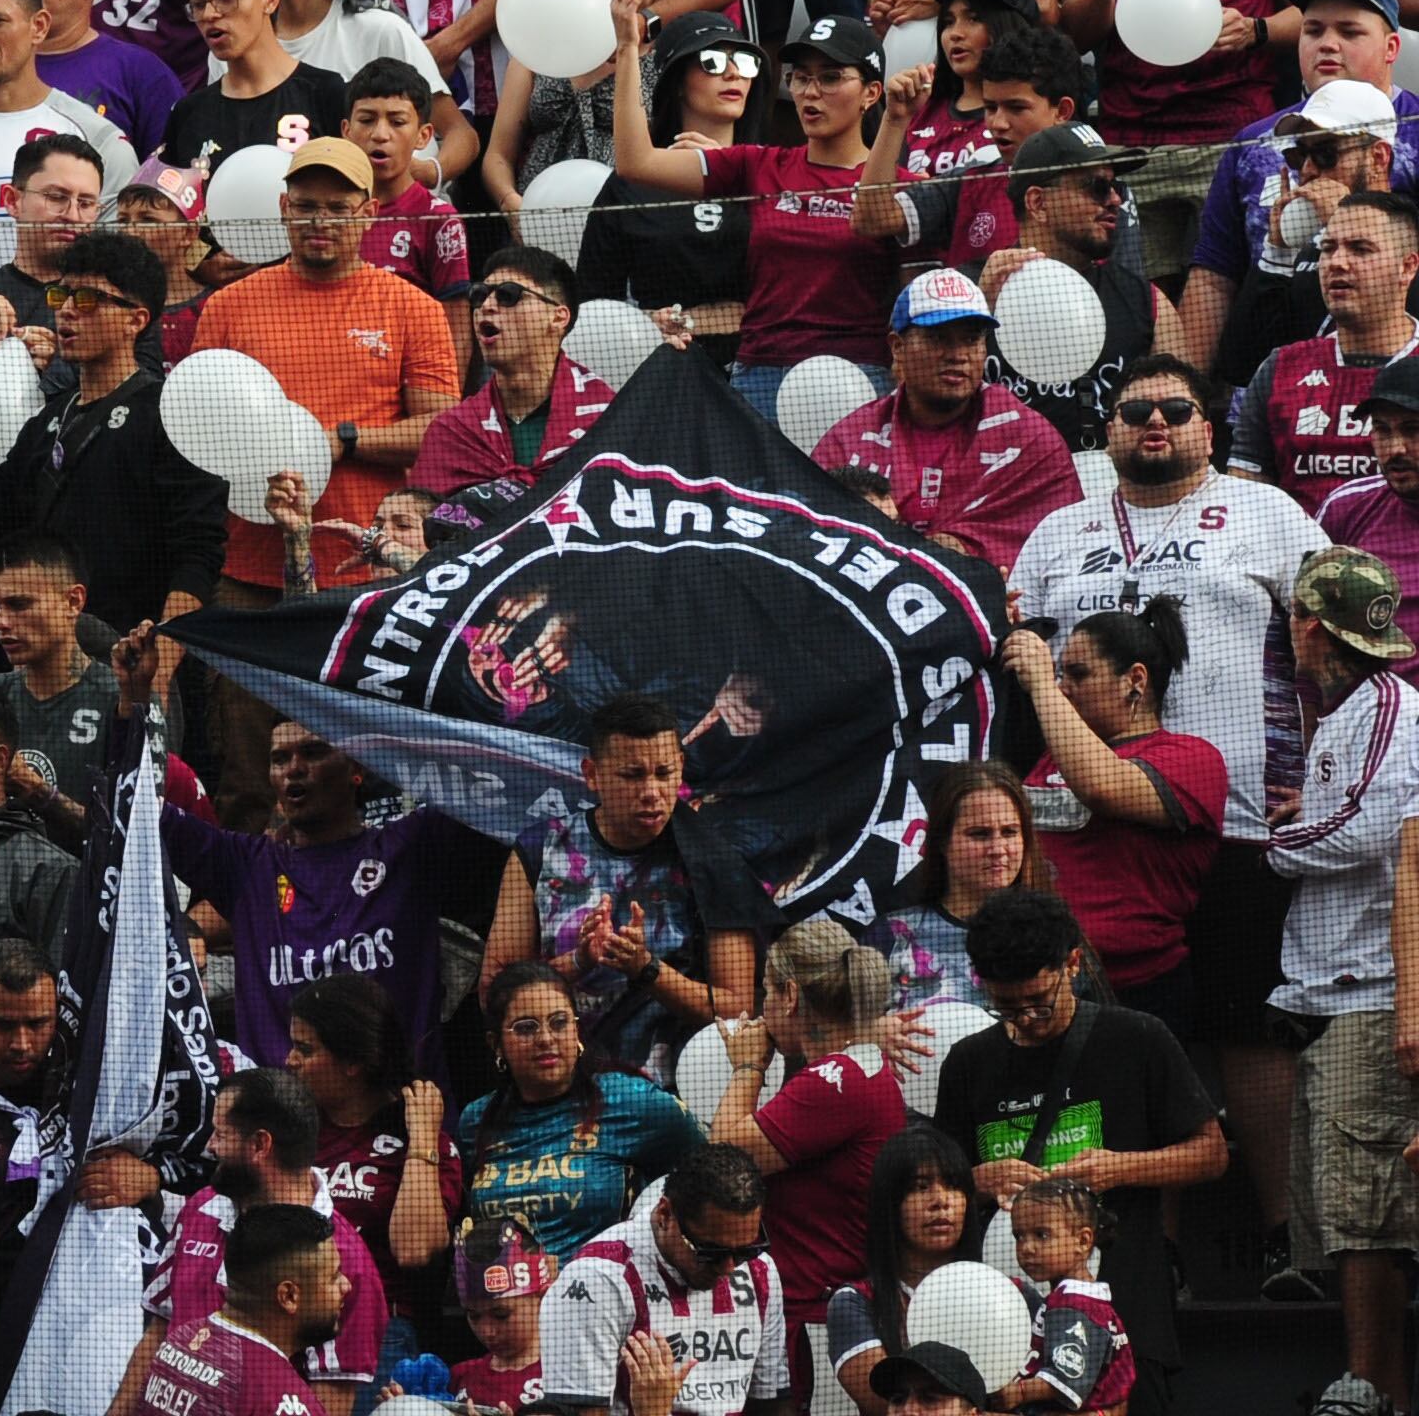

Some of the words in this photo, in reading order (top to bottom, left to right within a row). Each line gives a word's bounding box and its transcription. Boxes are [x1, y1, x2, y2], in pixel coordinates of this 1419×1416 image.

[809, 196, 857, 212] BAC
[1293, 453, 1385, 476] LIBERT
[610, 478, 771, 536] SUR
[1139, 540, 1207, 563] BAC
[357, 544, 504, 701] NTROL
[69, 709, 101, 744] S
[921, 655, 974, 763] LS
[326, 1163, 379, 1192] AC
[503, 1154, 586, 1184] BAC
[729, 1270, 755, 1307] S
[691, 1329, 754, 1363] BAC
[159, 1342, 226, 1387] GATORADE
[145, 1374, 199, 1412] WESLEY
